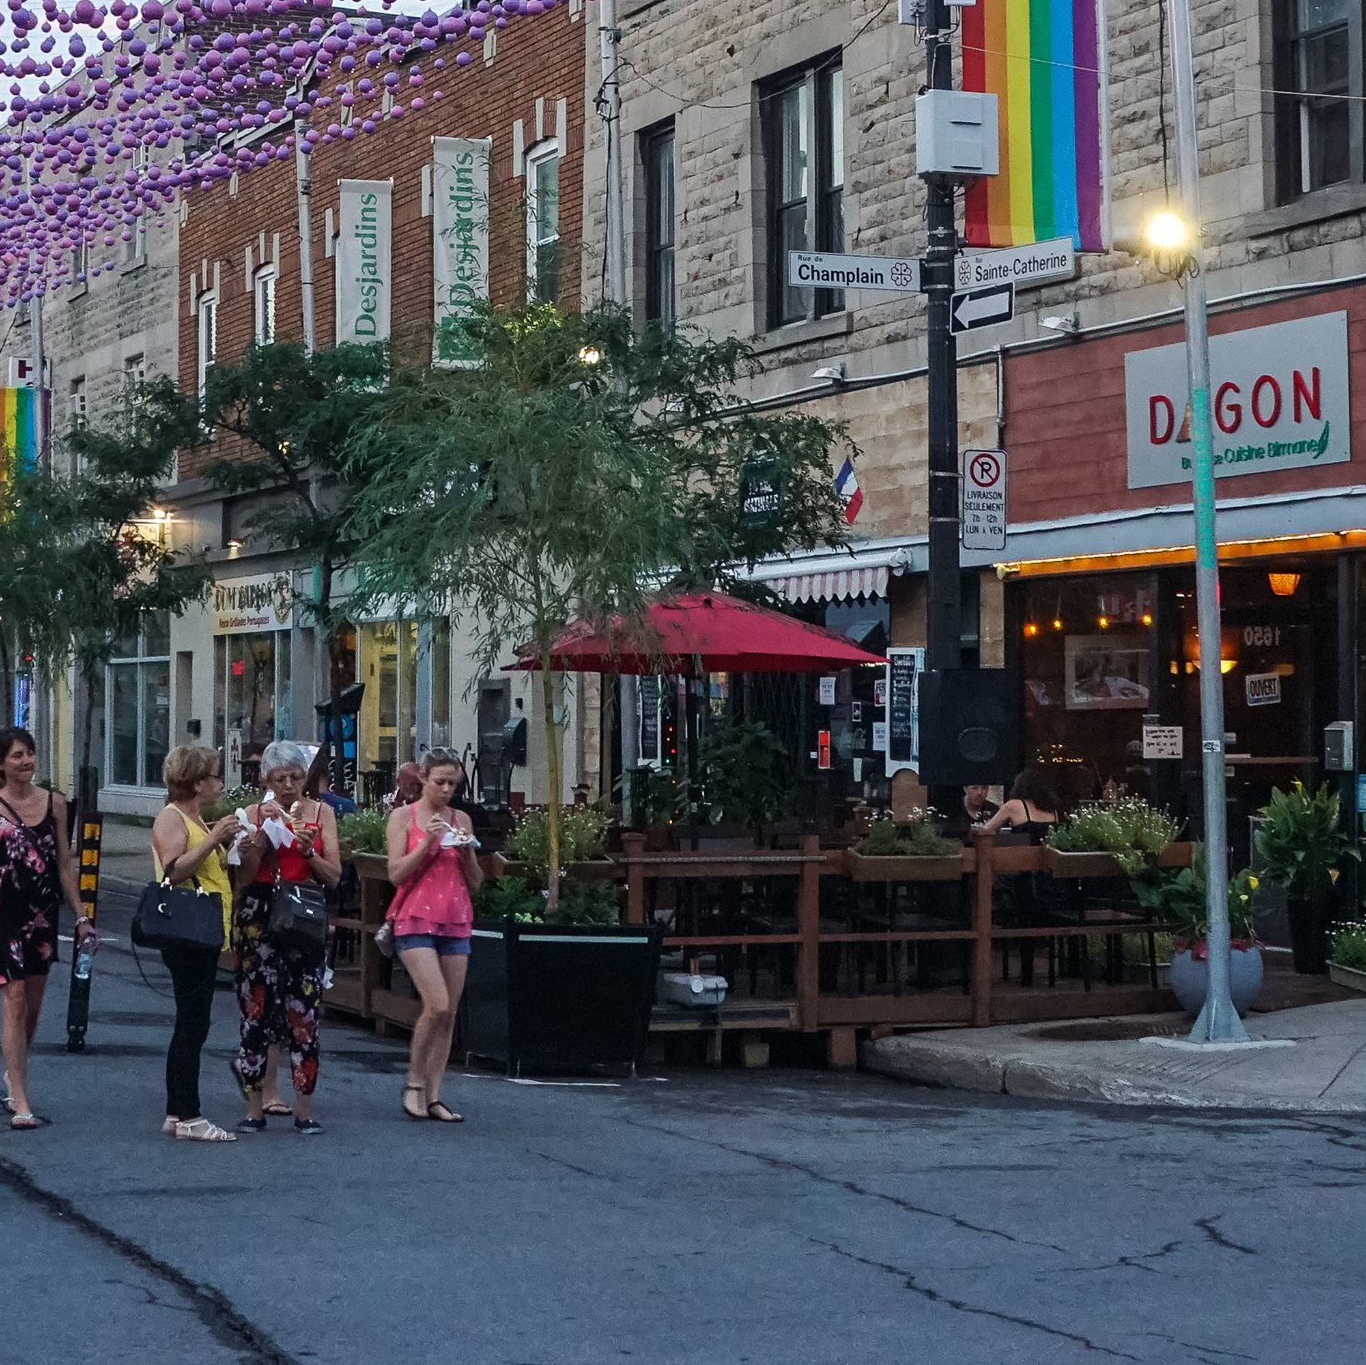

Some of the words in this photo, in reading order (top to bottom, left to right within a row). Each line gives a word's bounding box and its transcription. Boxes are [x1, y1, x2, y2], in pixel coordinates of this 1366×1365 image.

[449, 151, 481, 307] Desjardins
[354, 192, 384, 337] Desjardins
[797, 254, 812, 263] Rue
[813, 255, 823, 264] de
[974, 251, 1068, 283] Sainte-Catherine
[797, 263, 885, 287] Champlain
[1224, 444, 1265, 464] Cuisine
[1267, 438, 1320, 459] Birmane
[964, 501, 1005, 512] SEULEMENT
[966, 490, 1003, 500] LIVRAISON
[989, 525, 1003, 535] VEN
